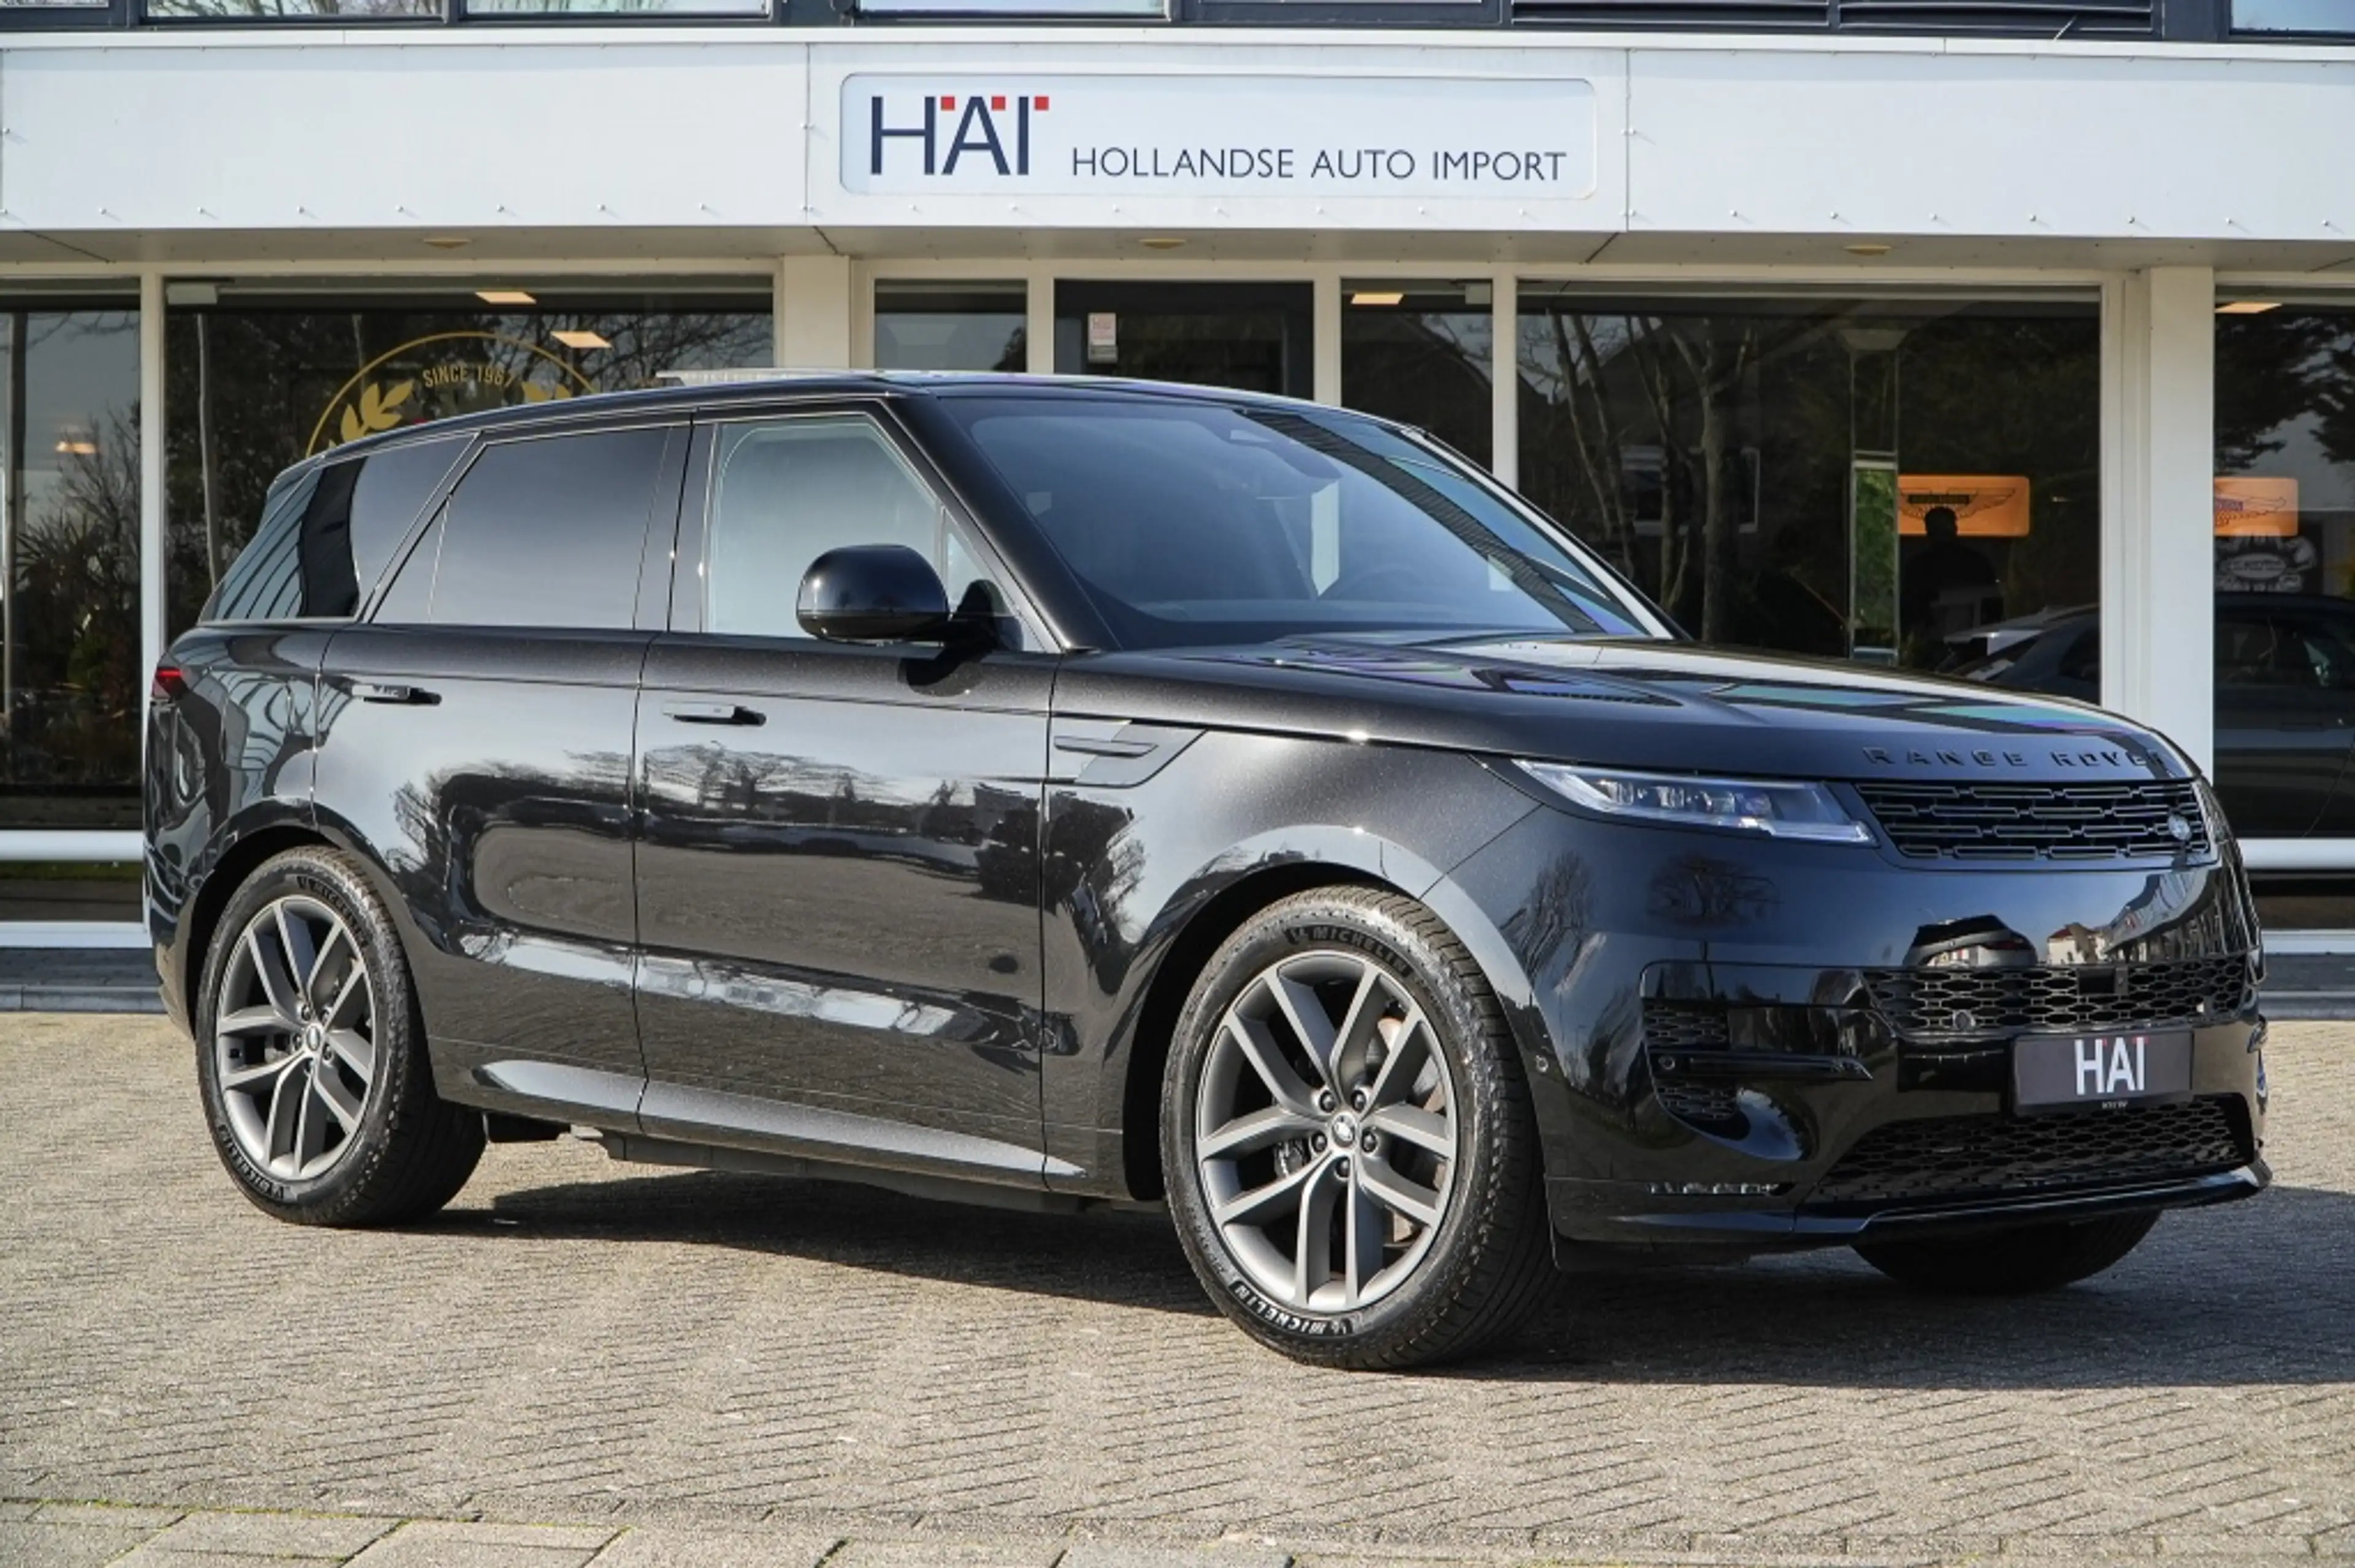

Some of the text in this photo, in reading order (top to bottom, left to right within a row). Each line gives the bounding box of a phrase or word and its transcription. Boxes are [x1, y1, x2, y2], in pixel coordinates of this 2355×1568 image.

[1073, 147, 1568, 182] HOLLANDSE AUTO IMPORT
[423, 365, 467, 388] SINCE
[1863, 746, 2167, 768] RANGE ROVER
[1312, 926, 1411, 973] MICHELIN
[2075, 1036, 2148, 1095] HAI
[1234, 1284, 1327, 1336] MICHELIN
